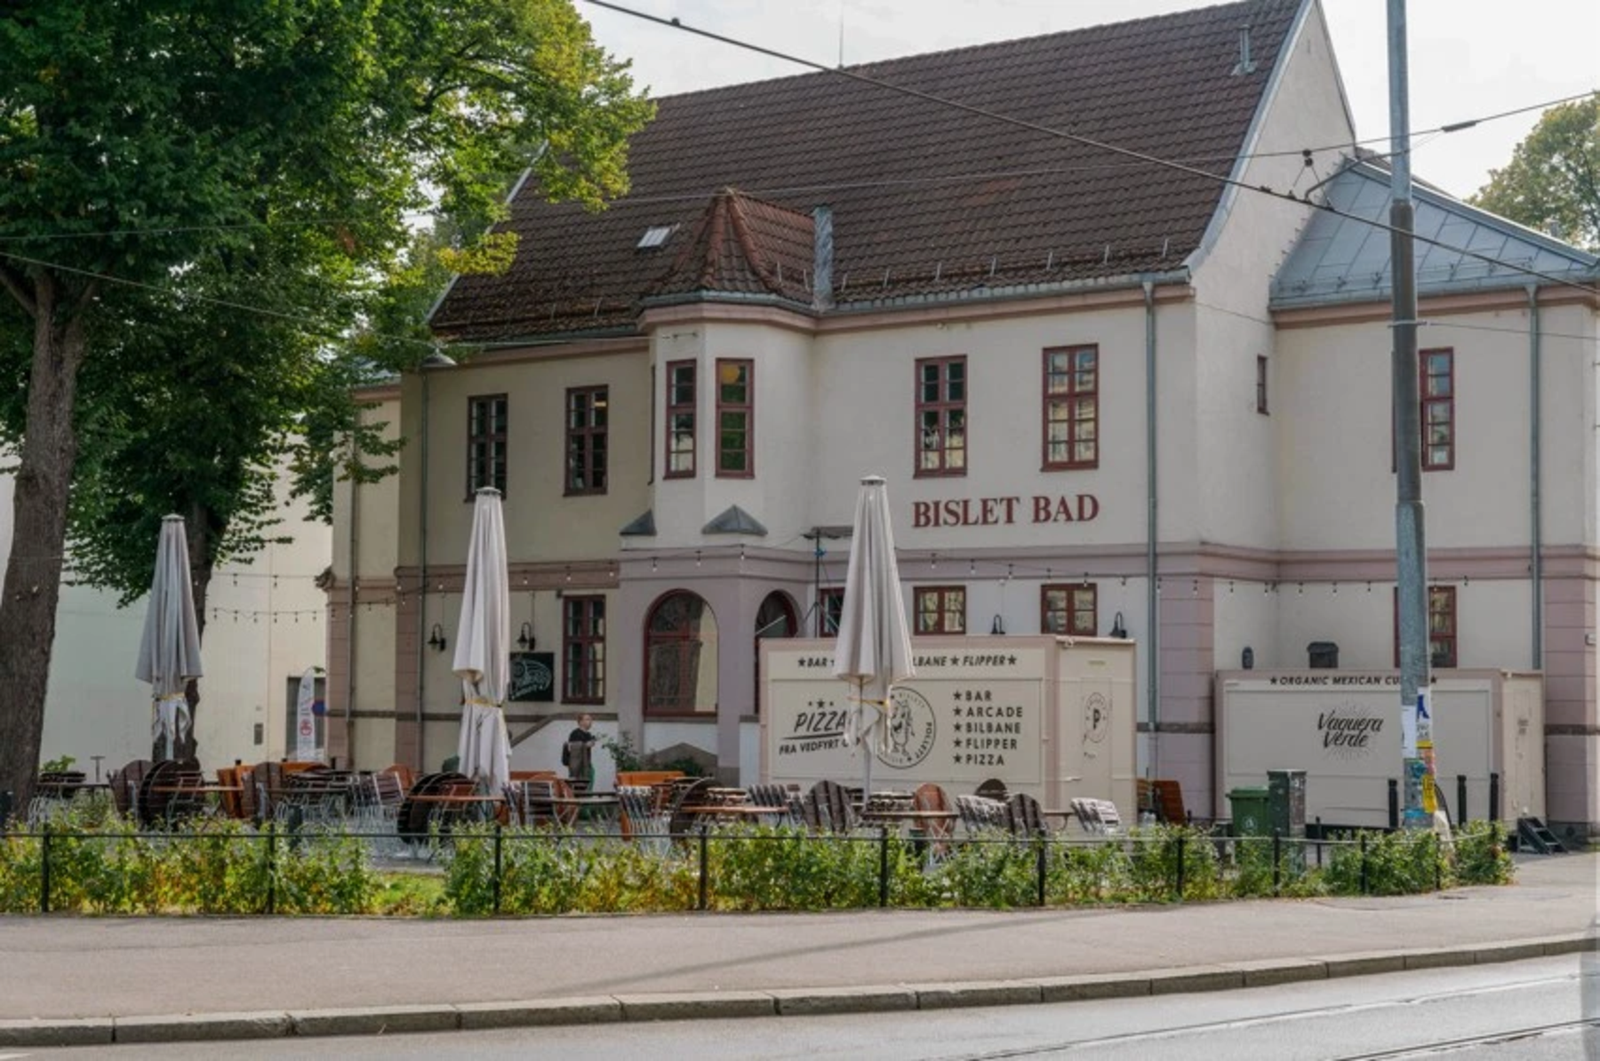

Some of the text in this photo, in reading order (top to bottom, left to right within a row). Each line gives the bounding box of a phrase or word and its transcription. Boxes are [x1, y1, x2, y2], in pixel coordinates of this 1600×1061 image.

[912, 494, 1099, 528] BISLET BAD
[807, 655, 1007, 668] BAR LBANE FLIPPER
[1279, 675, 1329, 686] ORGANIC
[1332, 675, 1382, 686] MEXICAN
[965, 689, 992, 701] BAR
[966, 706, 1023, 718] ARCADE
[793, 710, 847, 733] PIZZA
[965, 722, 1021, 734] BILBANE
[1317, 710, 1384, 735] Vaquera
[914, 722, 933, 759] POLLETT
[965, 738, 1018, 750] FLIPPER
[1323, 730, 1369, 748] Verde
[779, 744, 797, 756] FRA
[800, 739, 839, 753] VEDFYRT
[965, 754, 1005, 766] PIZZA
